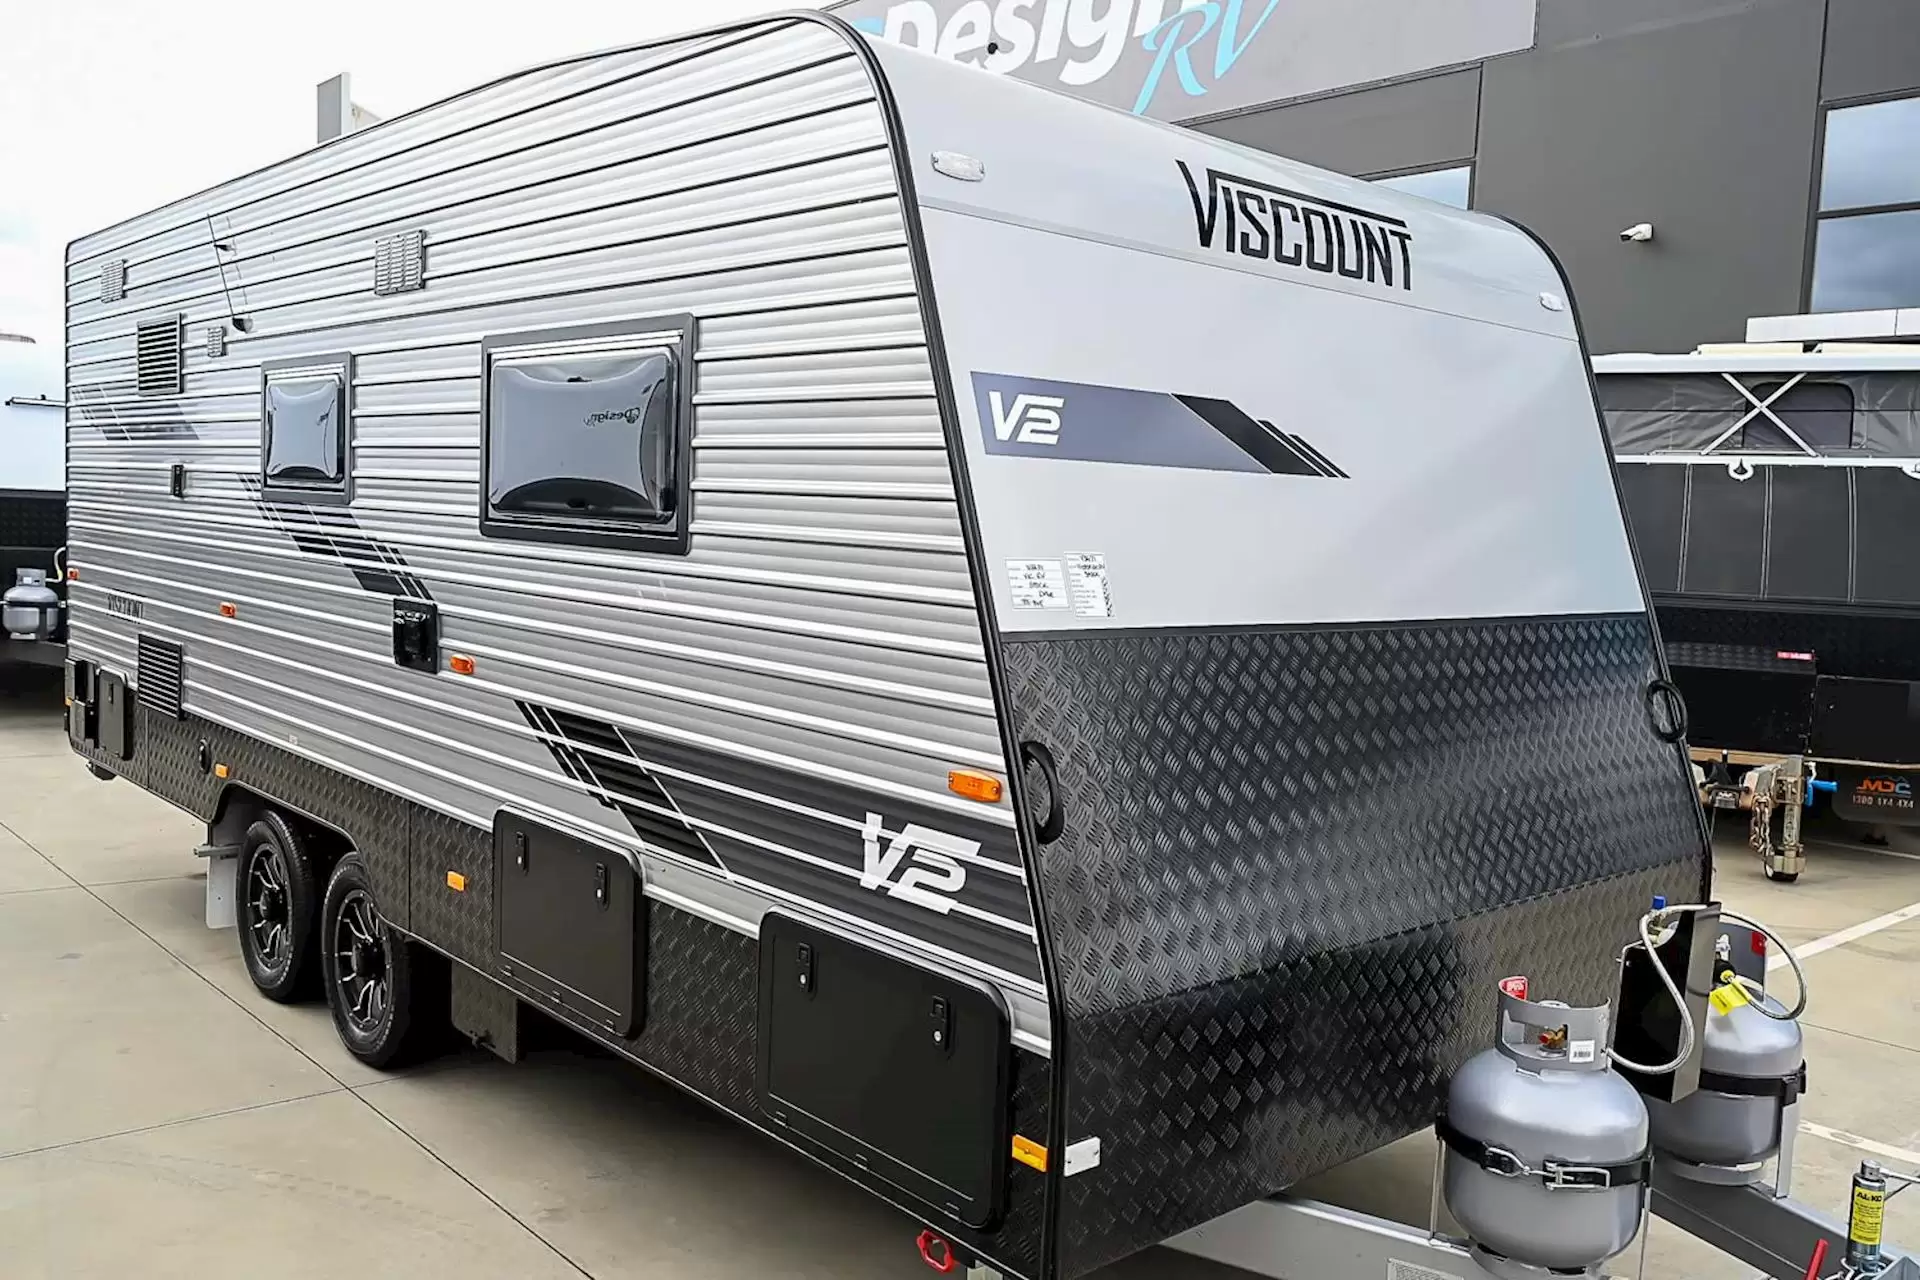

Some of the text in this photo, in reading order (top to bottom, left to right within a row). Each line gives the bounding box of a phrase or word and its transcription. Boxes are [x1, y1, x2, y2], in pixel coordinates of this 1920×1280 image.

[1176, 160, 1411, 290] VISCOUNT
[988, 391, 1065, 445] V2
[860, 811, 982, 915] V2
